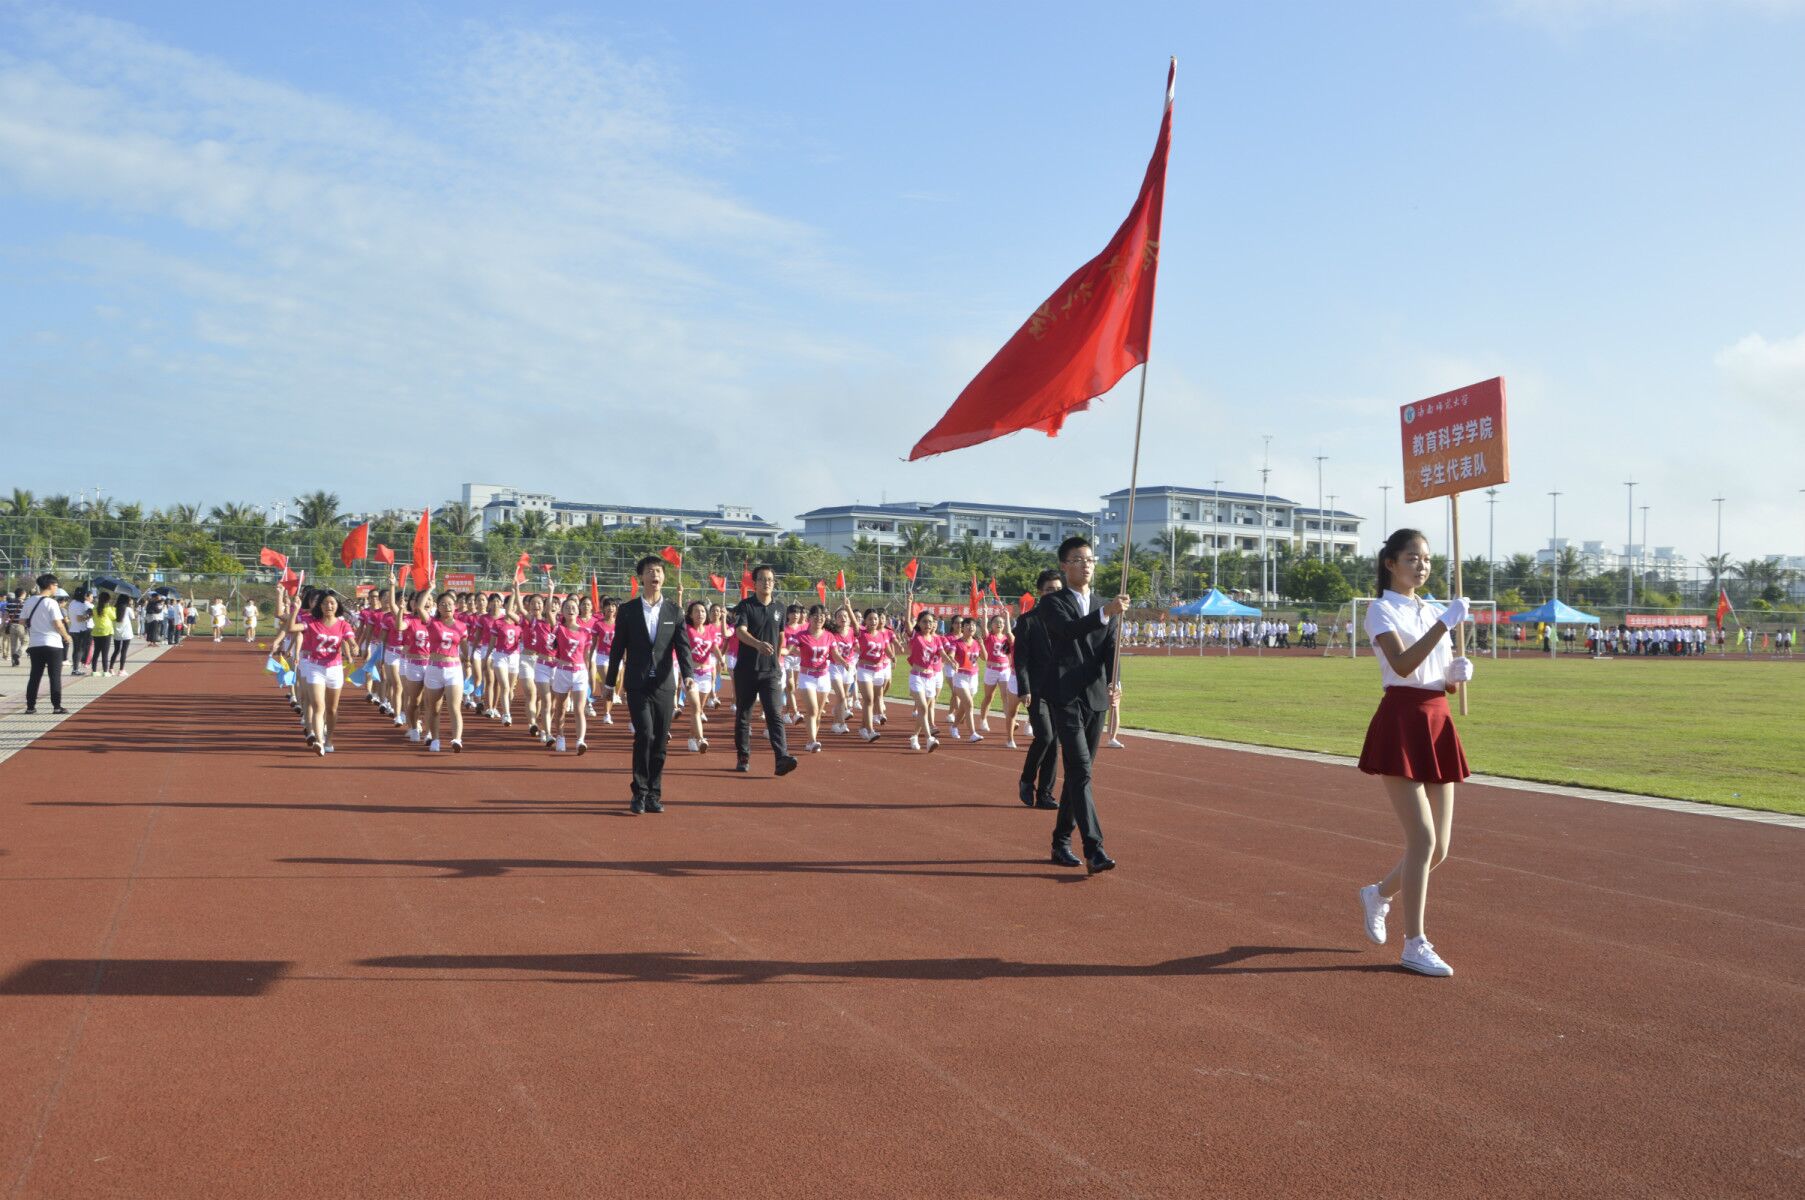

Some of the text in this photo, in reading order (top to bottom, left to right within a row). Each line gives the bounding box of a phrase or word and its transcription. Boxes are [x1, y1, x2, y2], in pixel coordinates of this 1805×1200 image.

[1412, 416, 1494, 456] 教育科学学院
[1420, 452, 1487, 488] 学生代表队
[316, 633, 340, 653] 22
[441, 631, 454, 650] 5
[567, 638, 580, 658] 7
